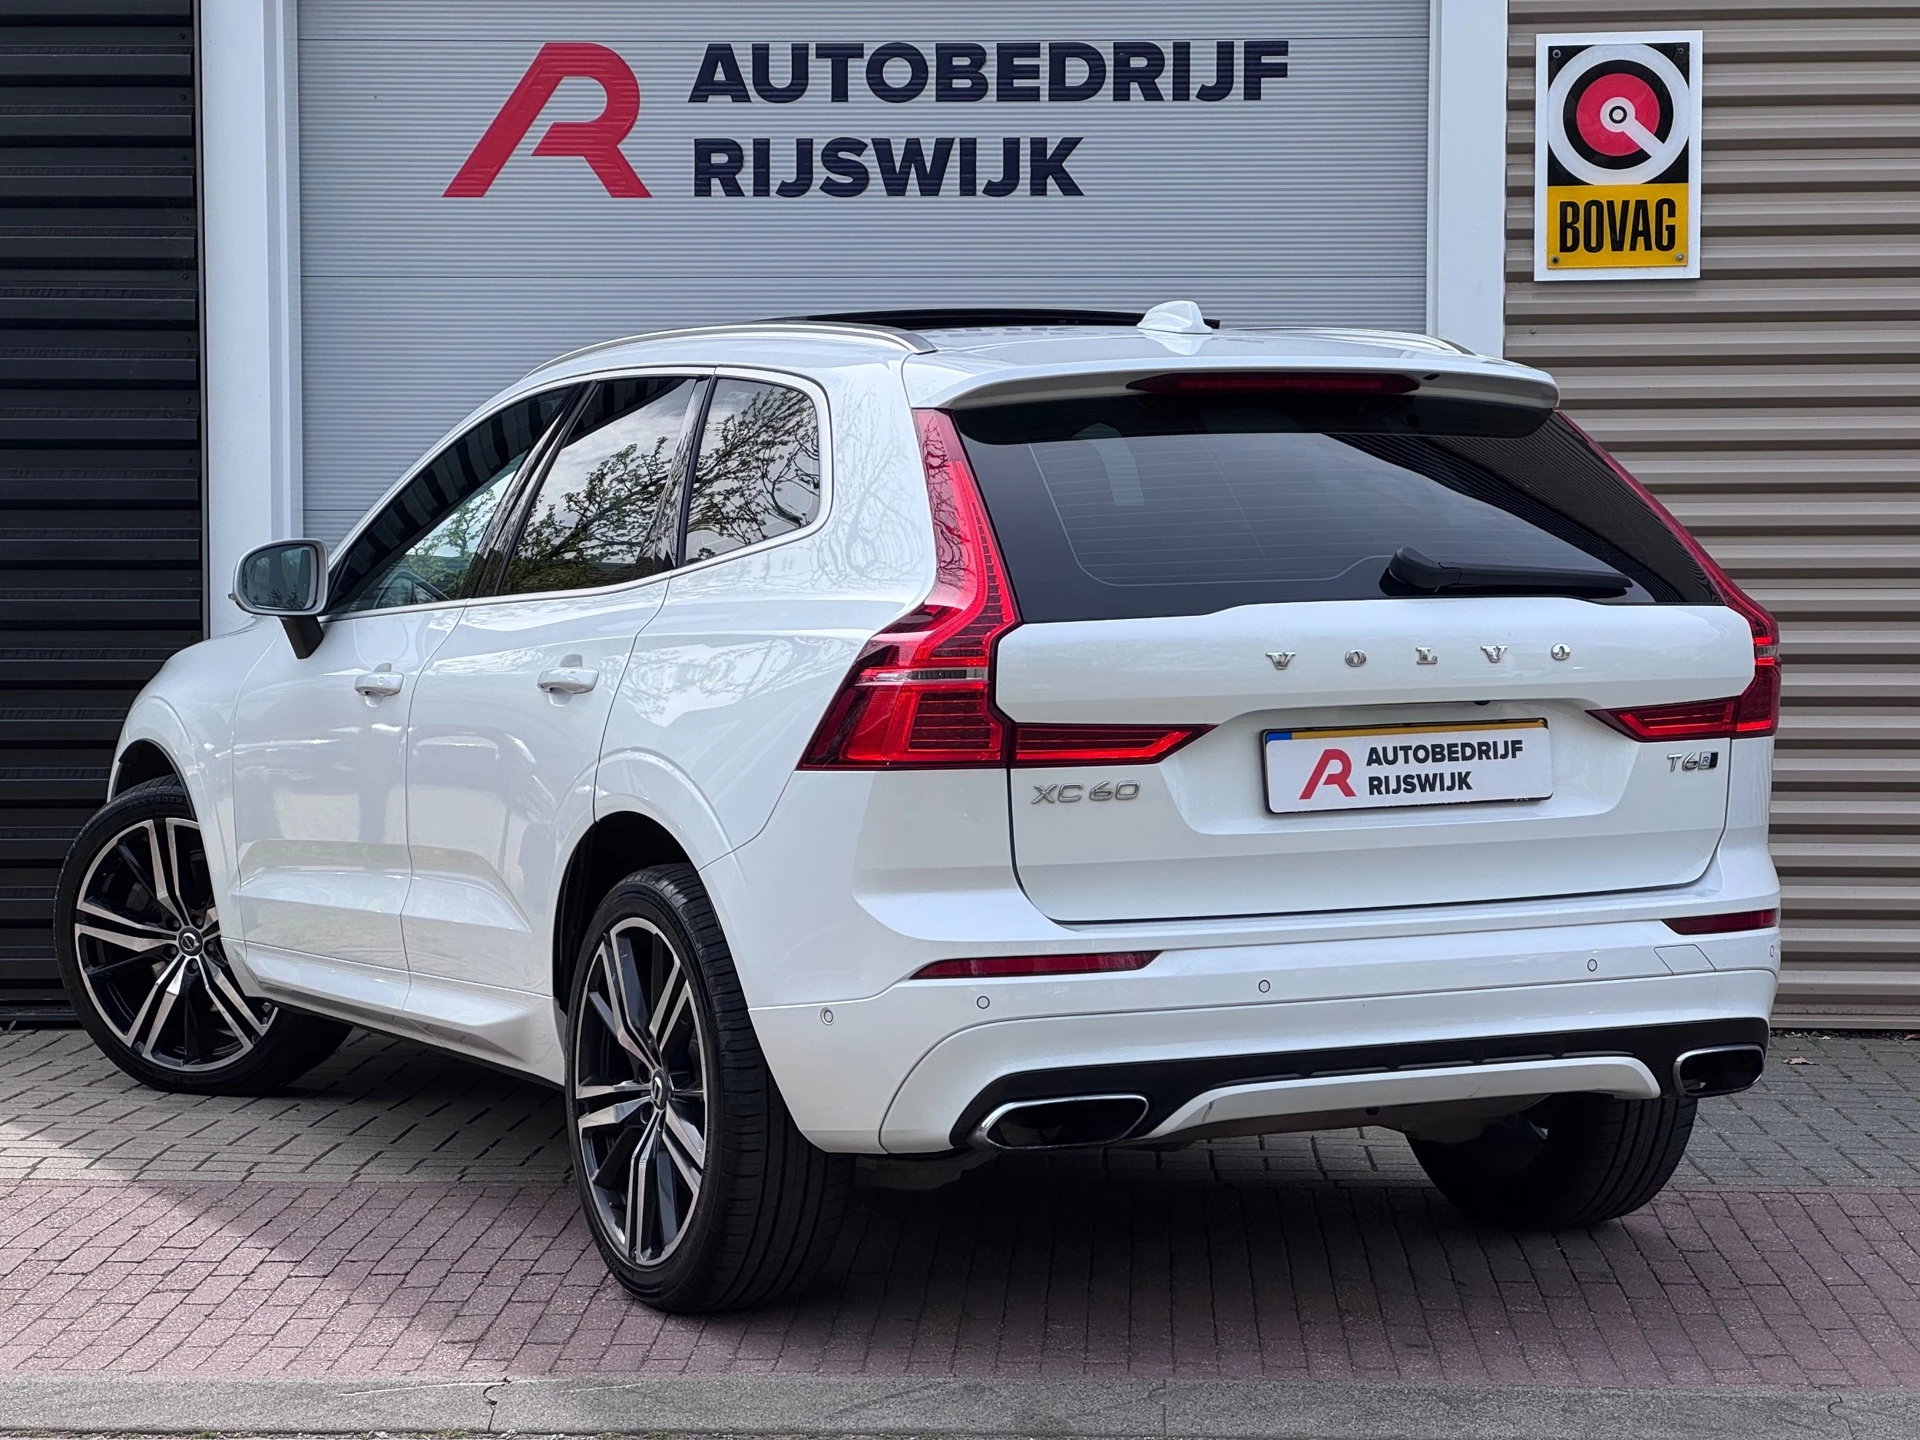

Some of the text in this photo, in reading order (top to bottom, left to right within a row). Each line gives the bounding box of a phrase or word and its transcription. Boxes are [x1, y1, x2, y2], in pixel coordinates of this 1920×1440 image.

[688, 41, 1289, 103] AUTOBEDRIJF
[693, 137, 1084, 197] RIJSWIJK
[1559, 197, 1676, 253] BOVAG
[1266, 643, 1571, 670] VOLVO
[1366, 739, 1524, 767] AUTOBEDRIJF
[1368, 771, 1473, 796] RIJSWIJK
